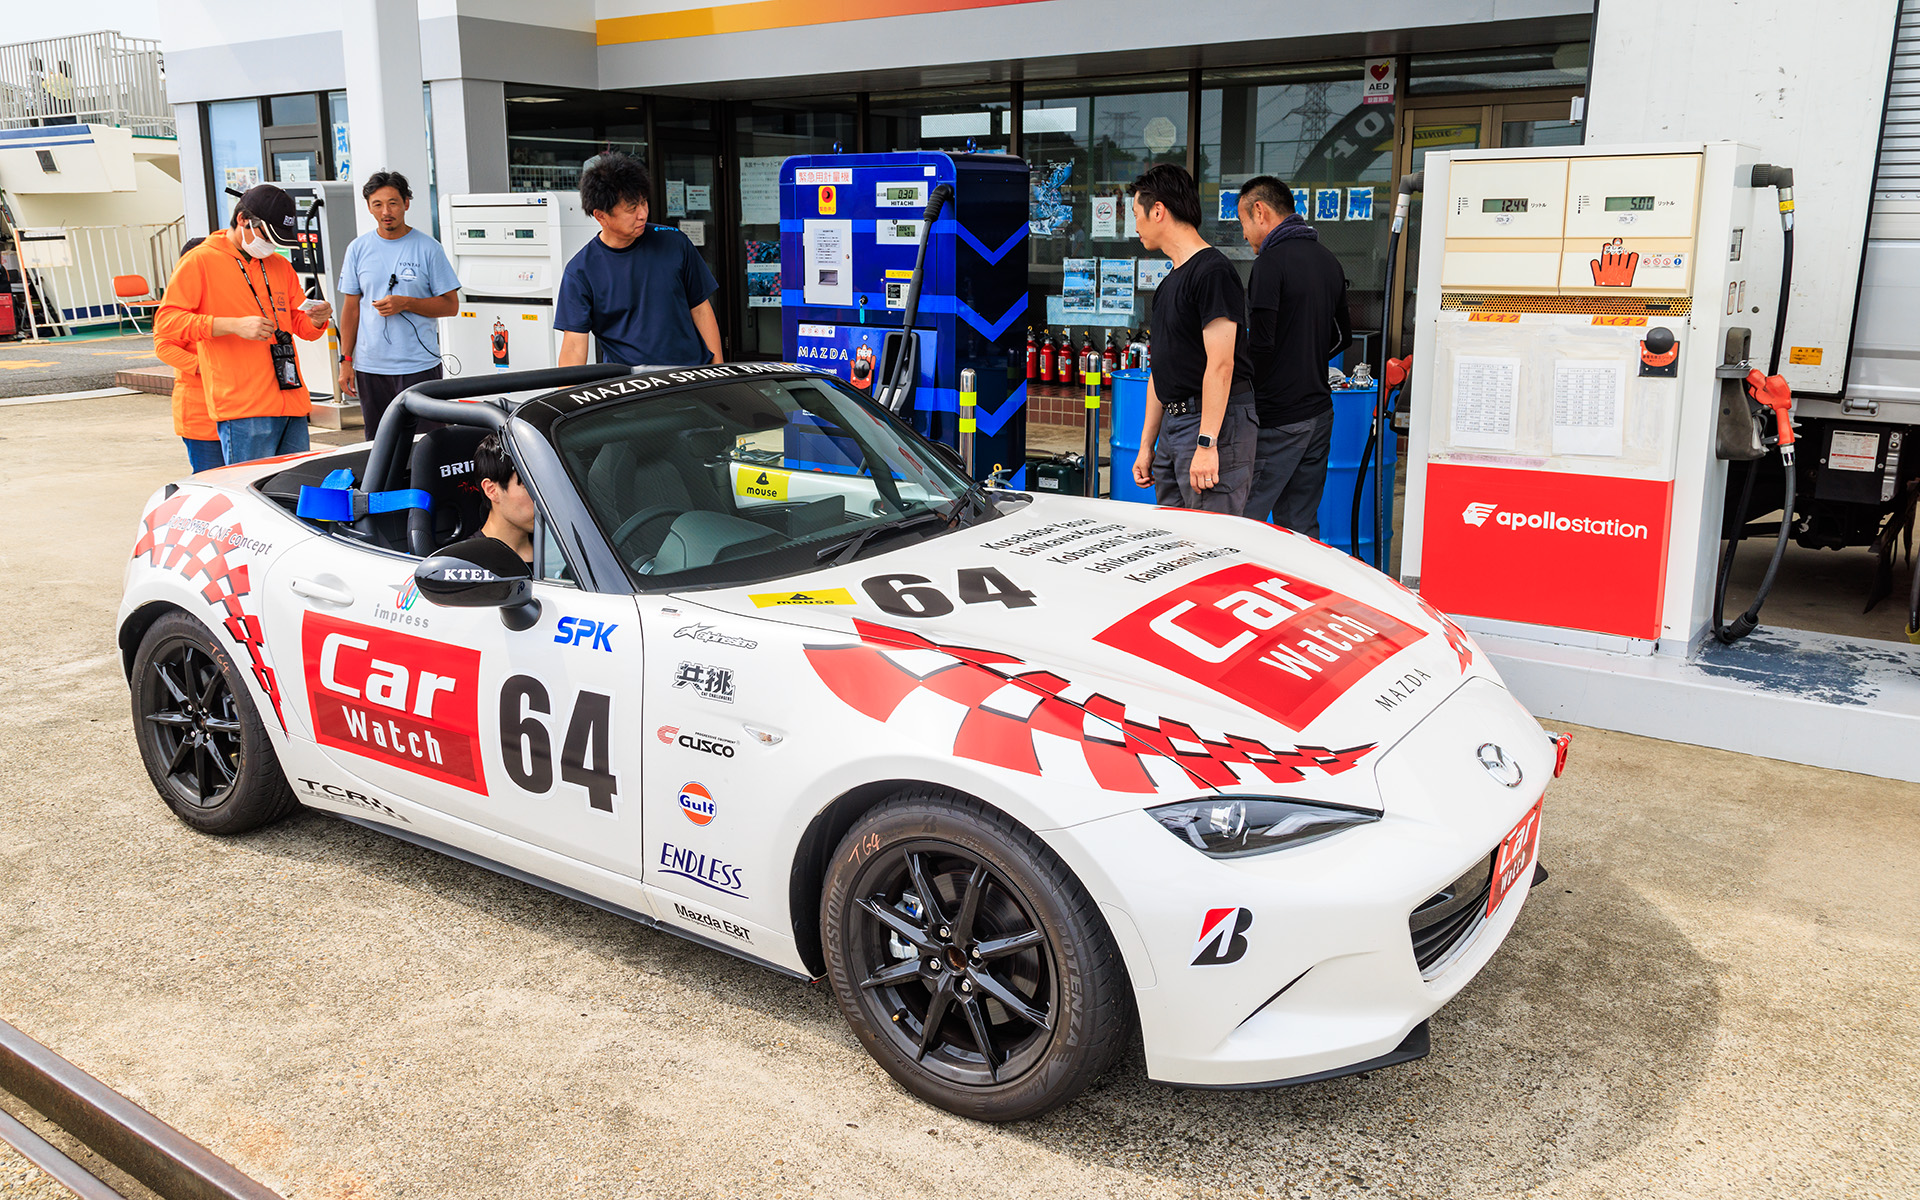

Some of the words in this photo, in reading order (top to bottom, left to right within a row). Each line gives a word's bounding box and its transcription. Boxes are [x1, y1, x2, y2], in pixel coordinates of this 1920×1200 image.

[1369, 82, 1390, 91] AED
[798, 171, 850, 183] 緊急用計量機
[1220, 188, 1372, 219] 無休憩所
[1501, 198, 1528, 212] 12.44
[1469, 313, 1520, 322] ハイオク
[1593, 316, 1648, 326] ハイオク
[798, 345, 849, 361] MAZDA
[569, 373, 670, 405] MAZDA
[669, 365, 744, 385] SPIRIT
[746, 486, 778, 498] mouse
[1496, 511, 1648, 539] apollostation
[230, 533, 272, 556] concept
[444, 568, 495, 581] KTEL
[777, 598, 835, 606] mouse
[861, 567, 1036, 618] 64
[374, 604, 430, 629] impress
[1149, 577, 1317, 664] Car
[554, 616, 619, 653] SPK
[1258, 613, 1380, 681] Watch
[320, 632, 457, 720] Car
[677, 664, 734, 696] 共挑
[1374, 668, 1431, 712] MAZDA
[342, 705, 444, 765] Watch
[500, 674, 618, 813] 64
[678, 734, 735, 759] CUSCO
[680, 794, 716, 816] Gulf
[1499, 815, 1535, 875] Car
[660, 842, 743, 890] ENDLESS
[674, 903, 722, 930] Mazda
[723, 920, 751, 941] E&T
[1054, 918, 1084, 1048] POTENZA
